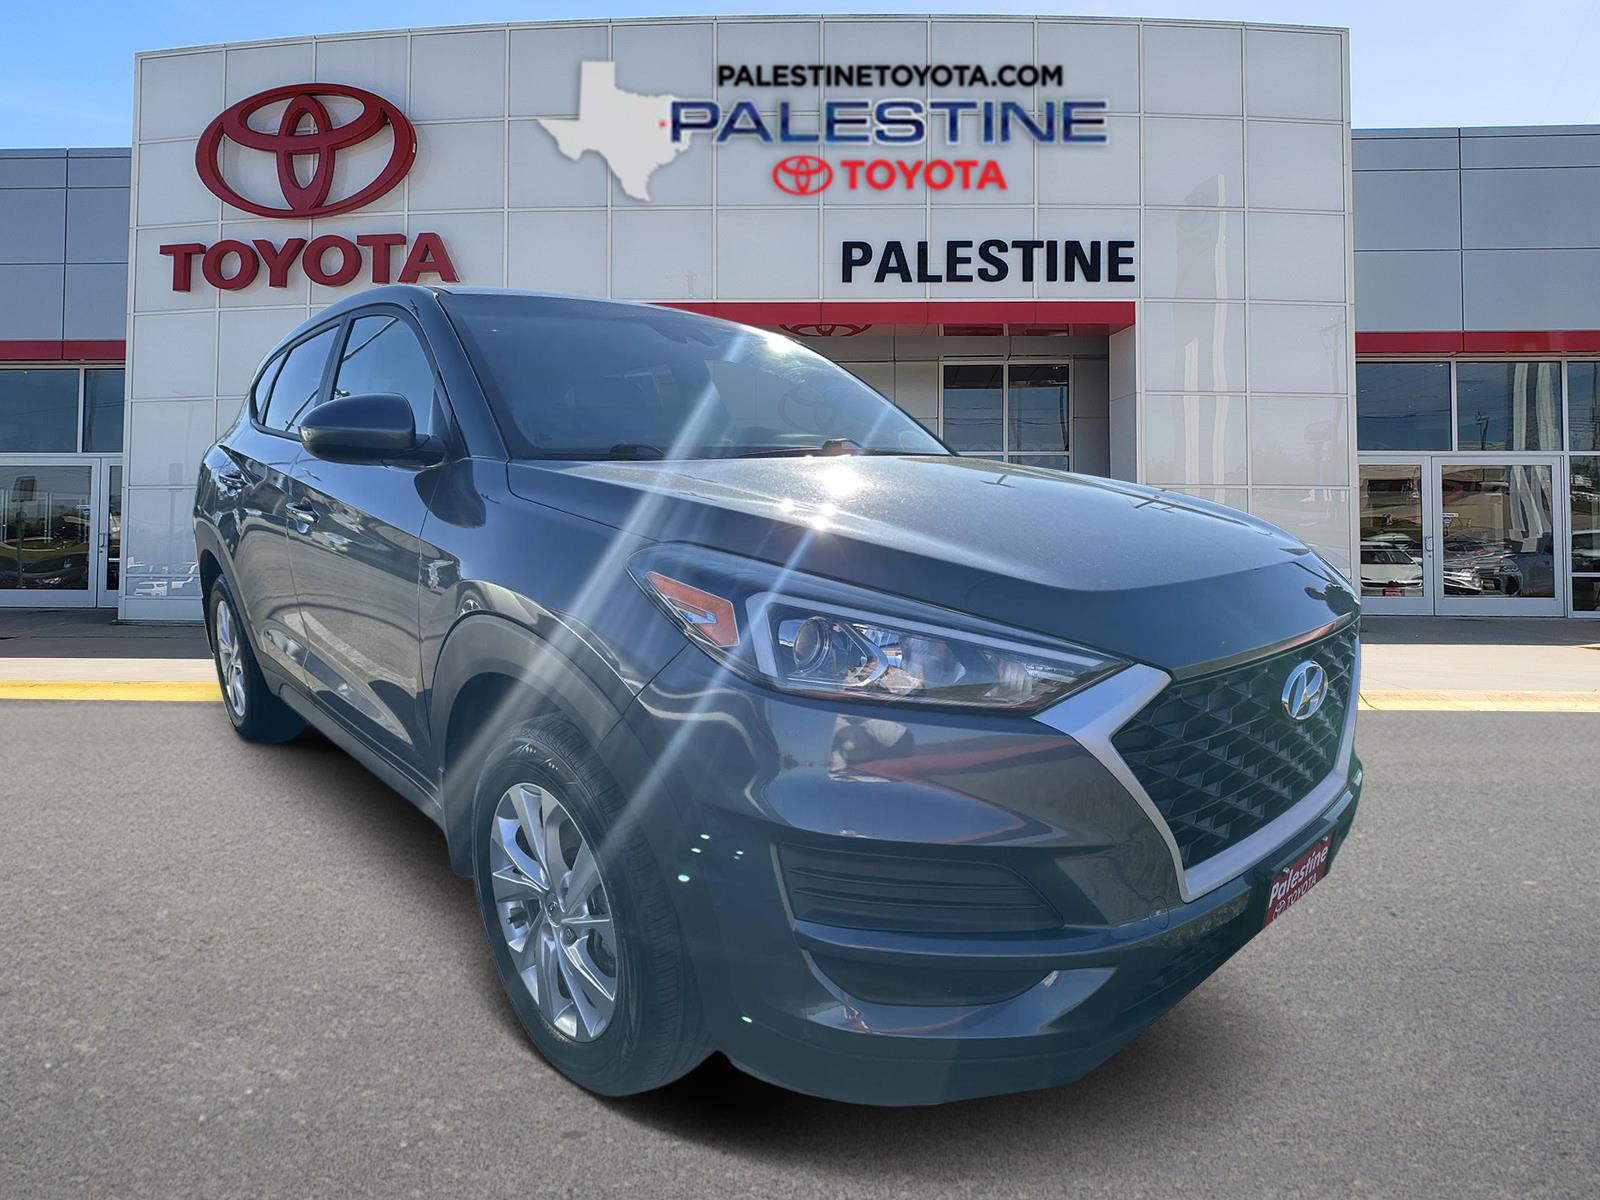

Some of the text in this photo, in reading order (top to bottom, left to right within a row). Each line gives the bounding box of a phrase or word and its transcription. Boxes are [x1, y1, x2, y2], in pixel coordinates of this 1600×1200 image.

[159, 232, 460, 292] TOYOTA
[841, 240, 1136, 283] PALESTINE
[1268, 846, 1328, 908] Palestine
[1286, 873, 1317, 908] TOYOTA
